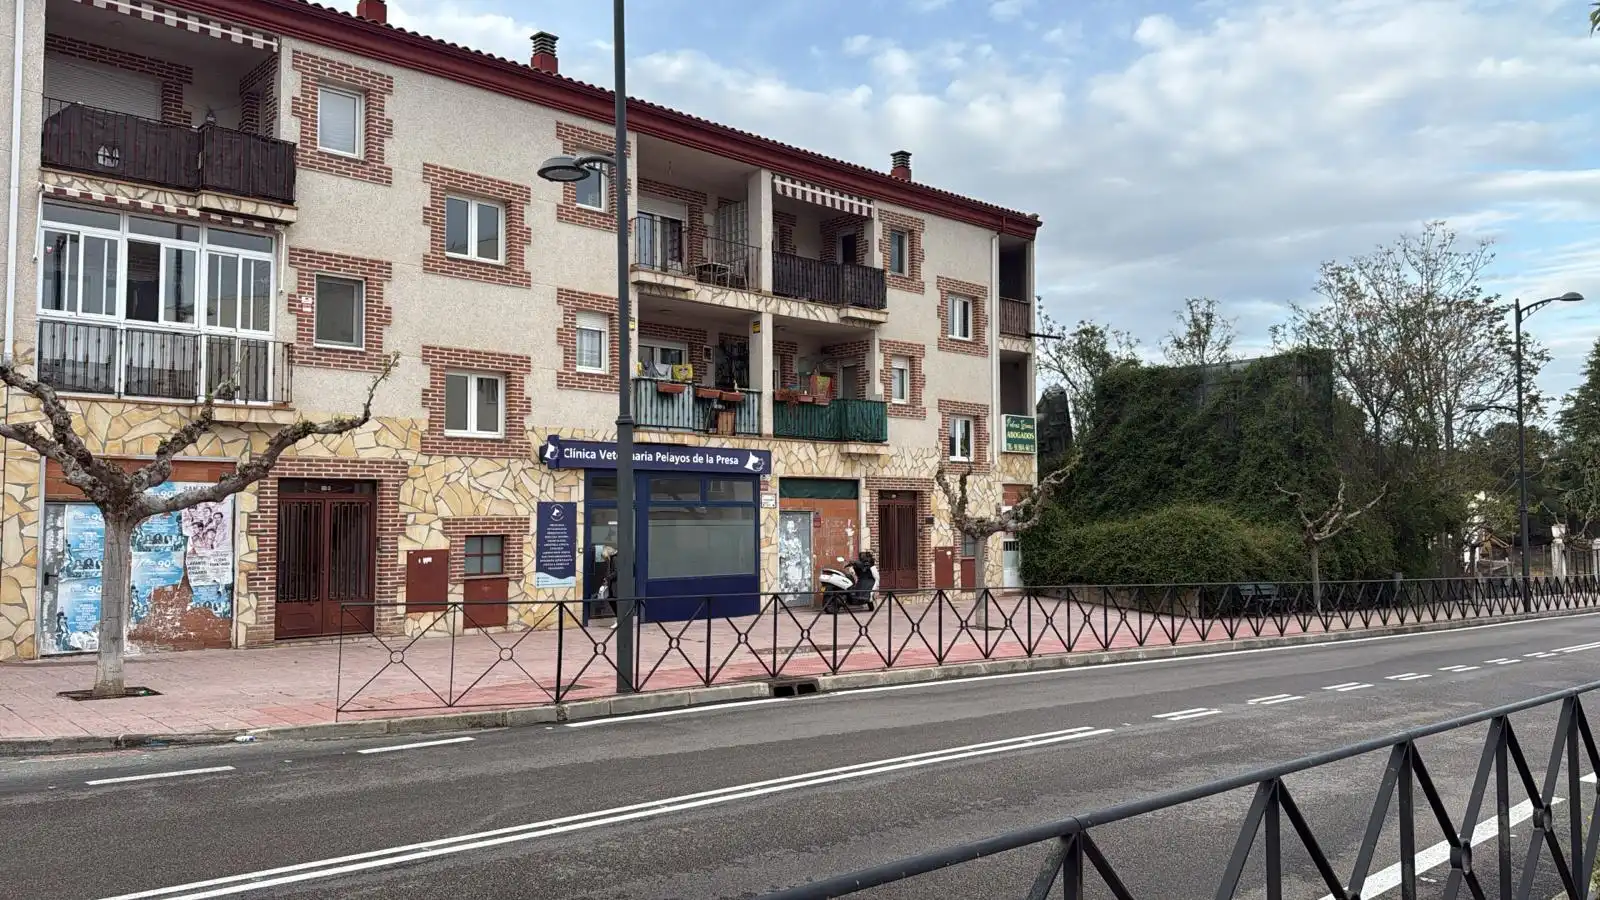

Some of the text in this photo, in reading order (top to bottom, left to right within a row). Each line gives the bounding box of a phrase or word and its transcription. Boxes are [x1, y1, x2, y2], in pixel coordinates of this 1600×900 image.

[1007, 431, 1035, 440] ABOGADOS
[564, 448, 739, 465] Clínica Vetaria Pelayos de la Presa
